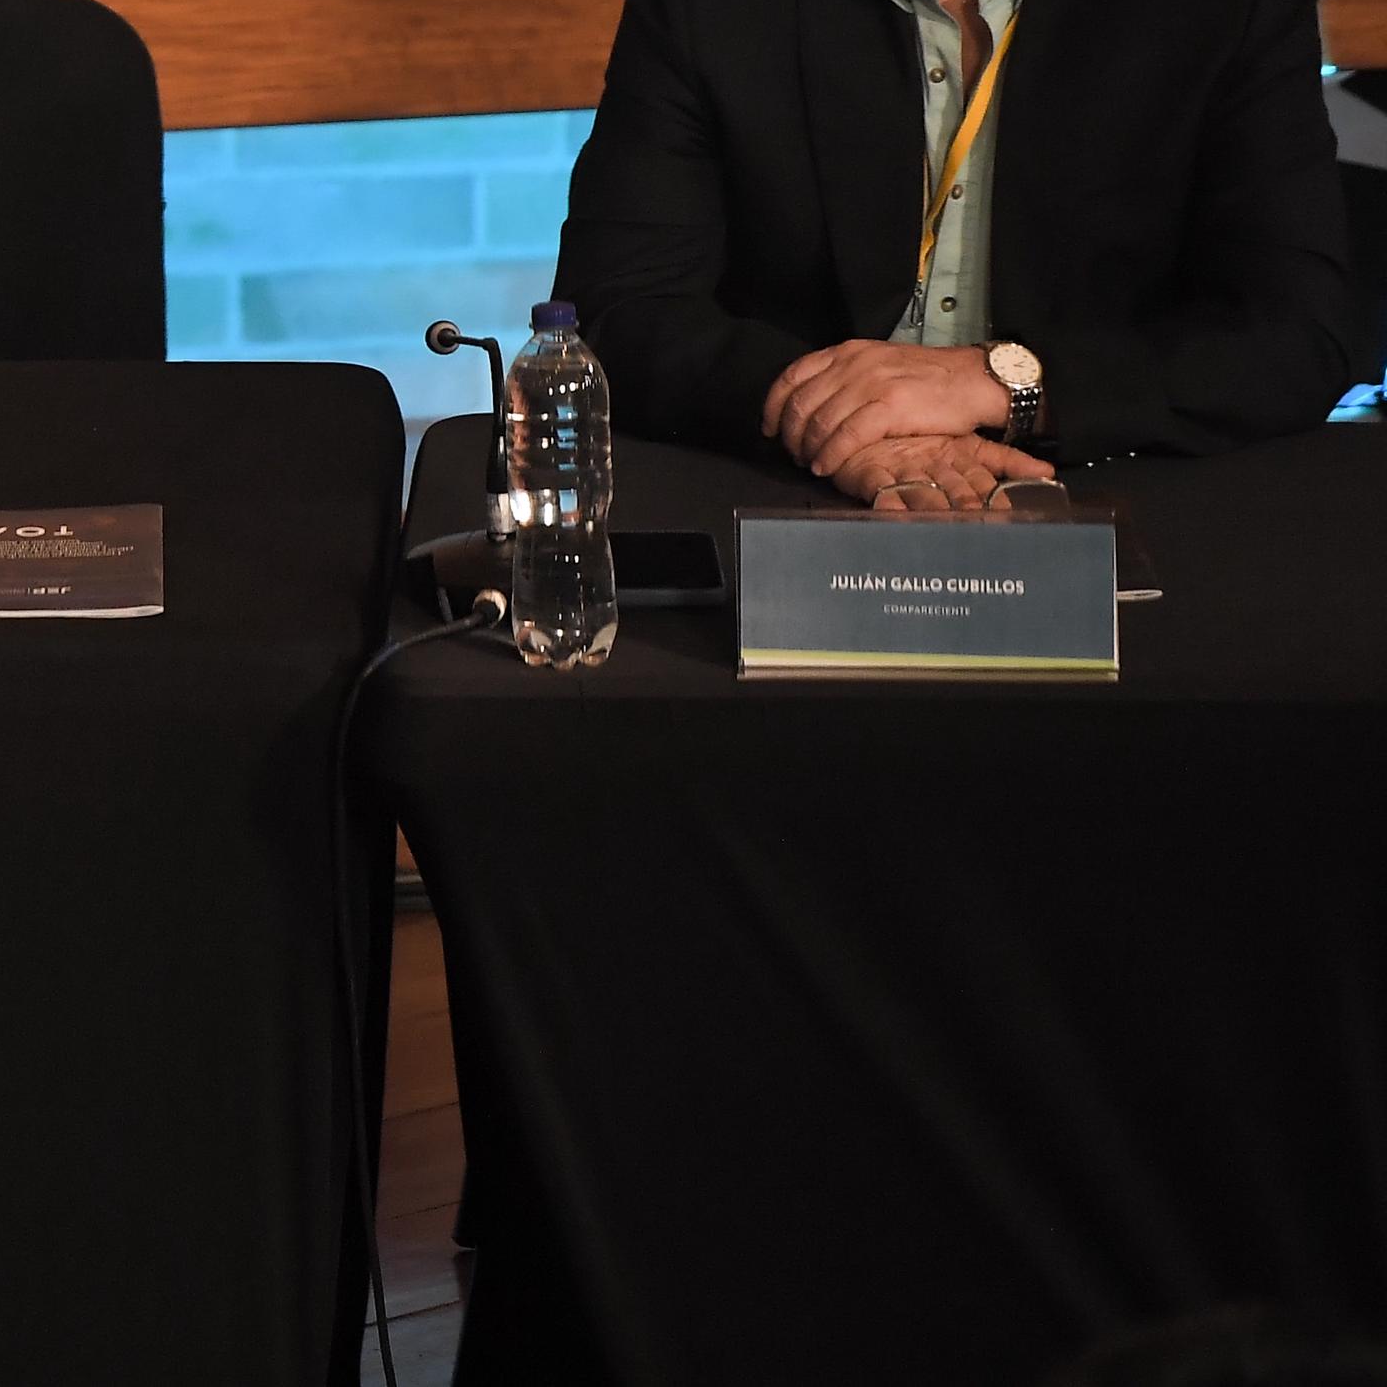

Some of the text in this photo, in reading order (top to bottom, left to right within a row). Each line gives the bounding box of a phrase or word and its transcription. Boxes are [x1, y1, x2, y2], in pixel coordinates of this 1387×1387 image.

[830, 573, 1025, 596] JULIÁN GALLO CUBILLOS
[883, 604, 971, 617] COMPARECIENTE
